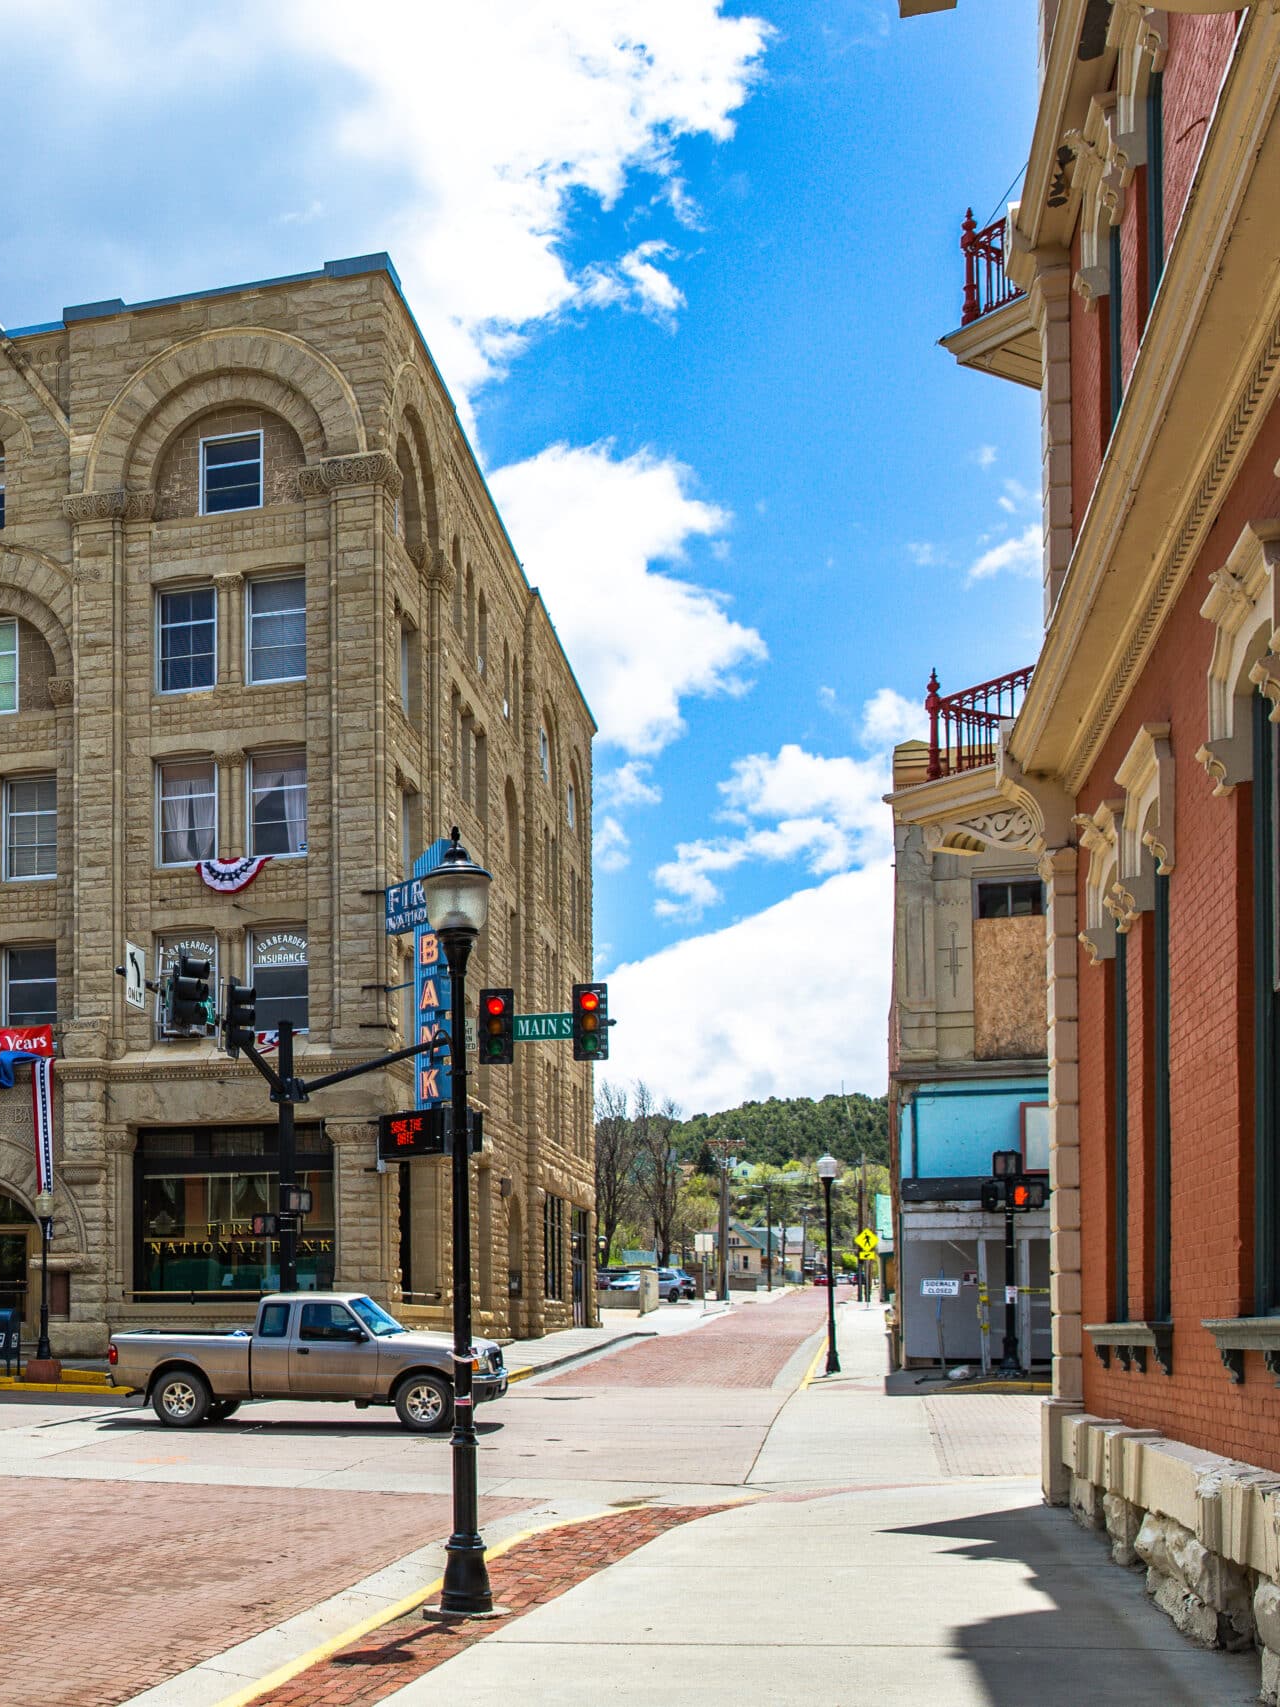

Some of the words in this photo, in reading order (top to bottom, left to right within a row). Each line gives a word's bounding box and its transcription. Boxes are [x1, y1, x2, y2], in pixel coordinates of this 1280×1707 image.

[388, 880, 427, 913] FIR
[386, 908, 427, 931] NATIO
[272, 934, 308, 950] BEARDEN
[258, 952, 306, 964] INSURANCE
[128, 986, 143, 1003] ONLY
[420, 933, 440, 1100] BANK
[518, 1018, 557, 1036] MAIN
[562, 1017, 574, 1035] S
[5, 1035, 47, 1052] Years
[14, 1107, 32, 1123] BA
[207, 1222, 254, 1237] FIRS
[150, 1240, 262, 1255] NATIONAL
[271, 1239, 335, 1254] BNK
